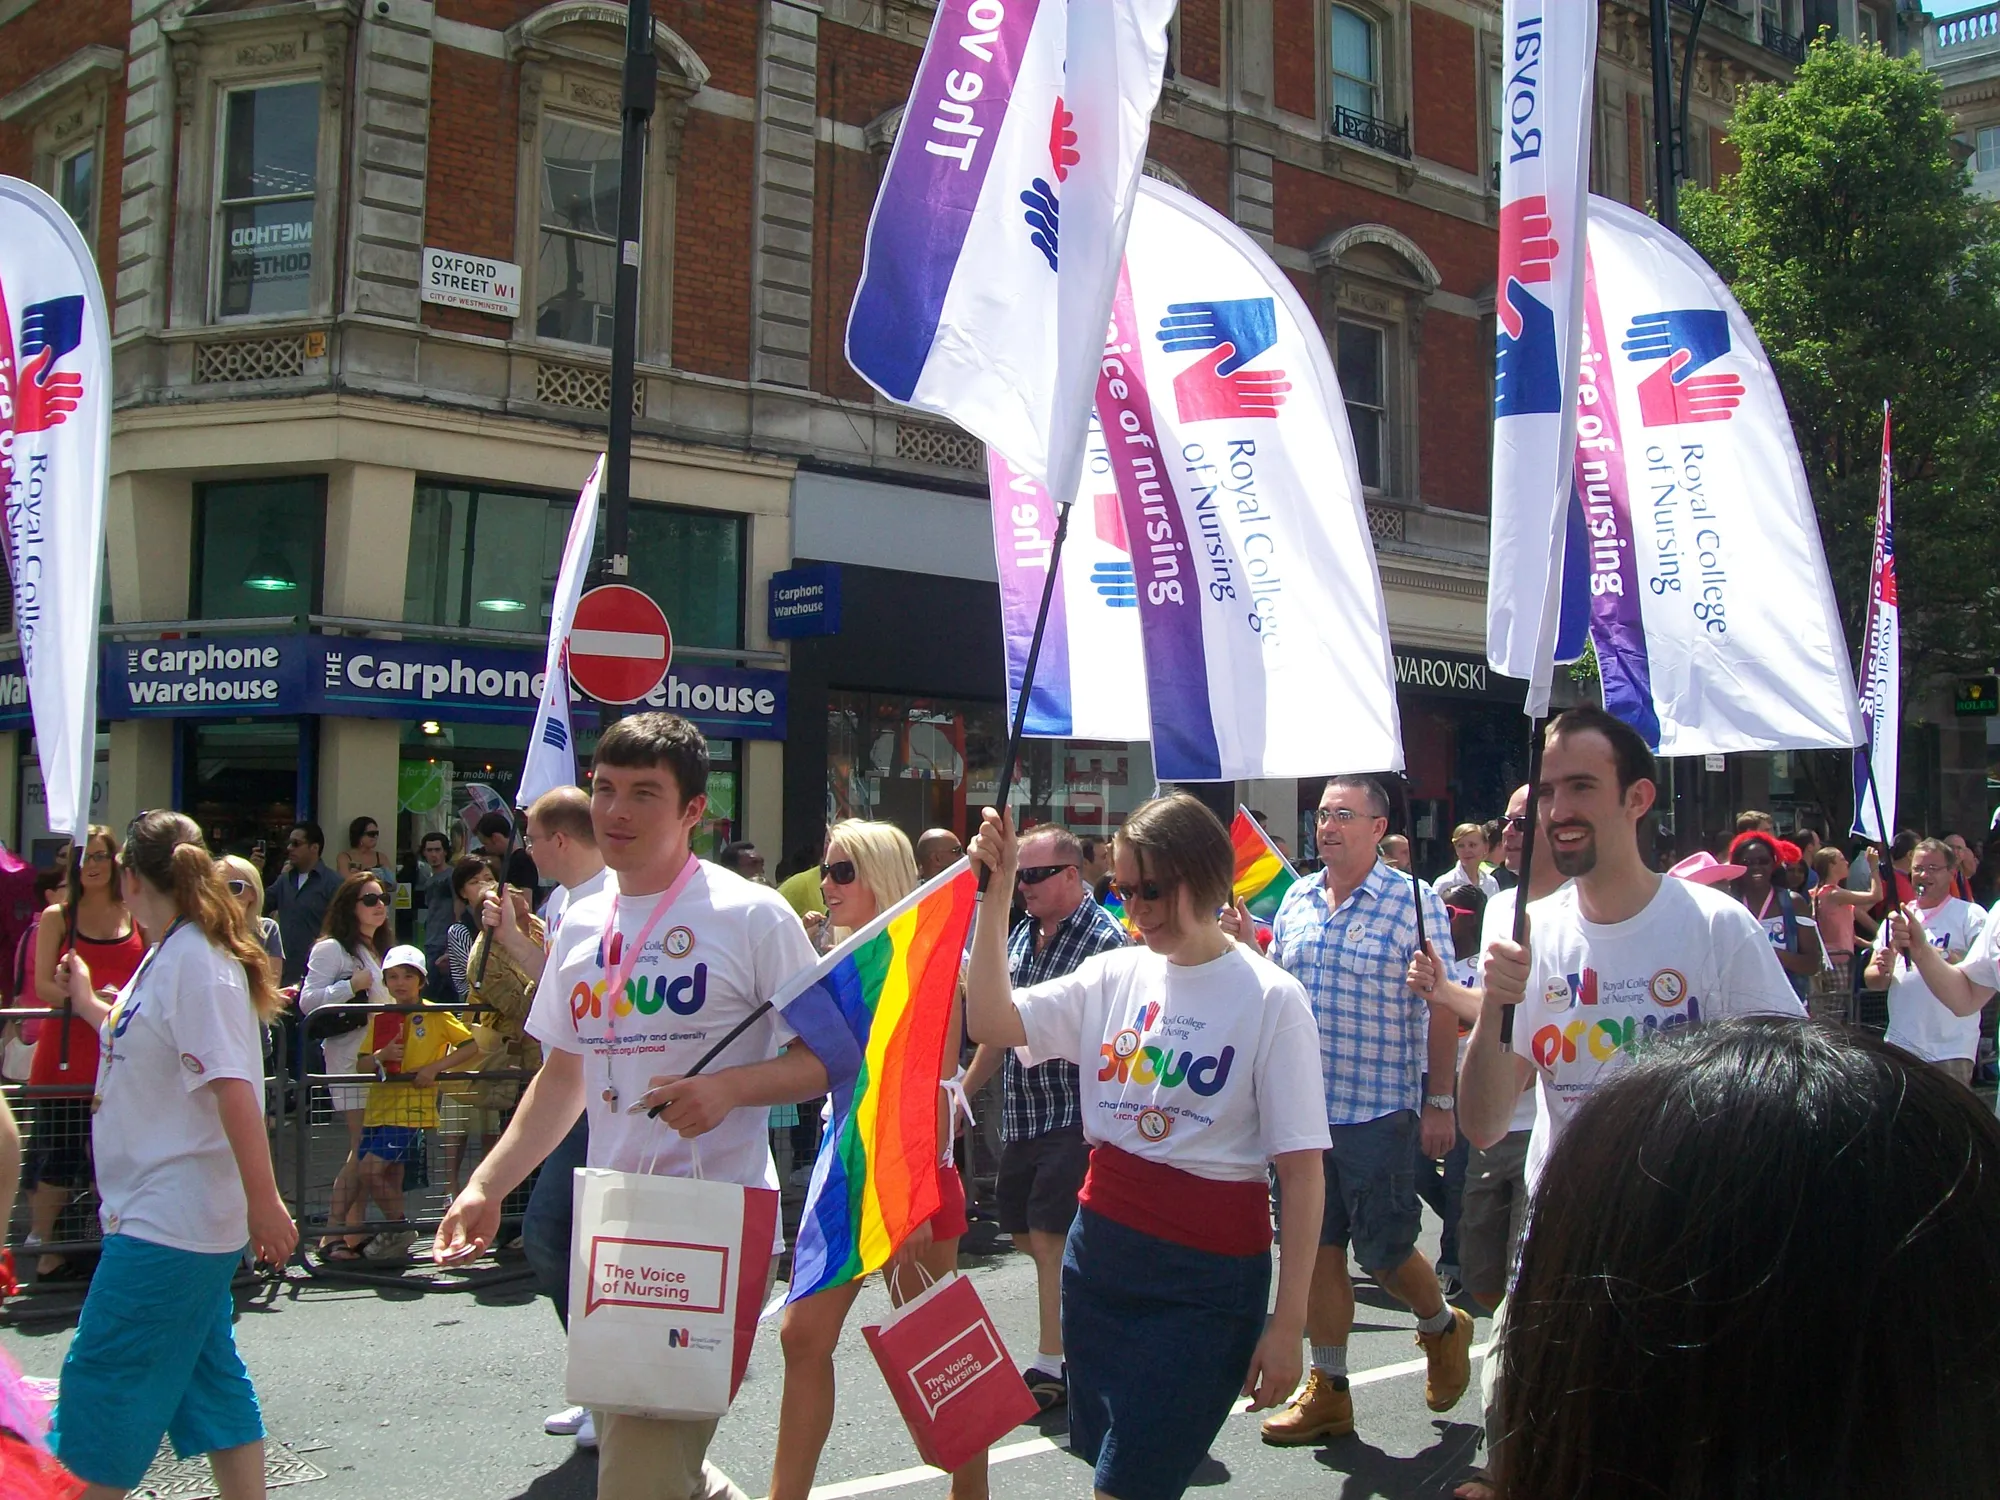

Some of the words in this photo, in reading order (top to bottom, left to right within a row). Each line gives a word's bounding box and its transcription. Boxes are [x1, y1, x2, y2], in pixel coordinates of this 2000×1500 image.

[230, 252, 312, 278] METHOD
[431, 255, 496, 278] OXFORD
[431, 272, 489, 293] STREET
[429, 292, 445, 301] CITY
[447, 295, 457, 303] OF
[459, 297, 508, 312] WESTMINSTER
[1119, 410, 1155, 449] of
[1577, 414, 1616, 452] of
[1182, 443, 1218, 474] of
[1646, 446, 1675, 475] of
[24, 454, 48, 544] Royal
[1221, 439, 1271, 523] Royal
[1678, 443, 1716, 520] Royal
[1132, 456, 1185, 606] nursing
[1190, 484, 1238, 602] Nursing
[1582, 460, 1625, 597] nursing
[1650, 483, 1686, 595] Nursing
[778, 584, 824, 601] Carphone
[1244, 533, 1282, 646] College
[1694, 529, 1727, 634] College
[774, 602, 823, 618] Warehouse
[128, 649, 139, 675] THE
[141, 644, 279, 676] Carphone
[1391, 655, 1487, 691] WAROVSKI
[128, 677, 279, 703] Warehouse
[325, 651, 342, 689] THE
[346, 654, 547, 700] Carphone
[645, 675, 776, 715] ehouse
[1956, 699, 1996, 710] ROLEX
[570, 962, 708, 1033] proud
[1177, 1015, 1206, 1030] College
[602, 1280, 619, 1293] of
[623, 1281, 690, 1302] Nursing
[604, 1263, 635, 1279] The
[640, 1266, 686, 1283] Voice
[924, 1373, 945, 1390] The
[944, 1353, 974, 1375] Voice
[931, 1387, 942, 1400] of
[942, 1360, 982, 1392] Nursing
